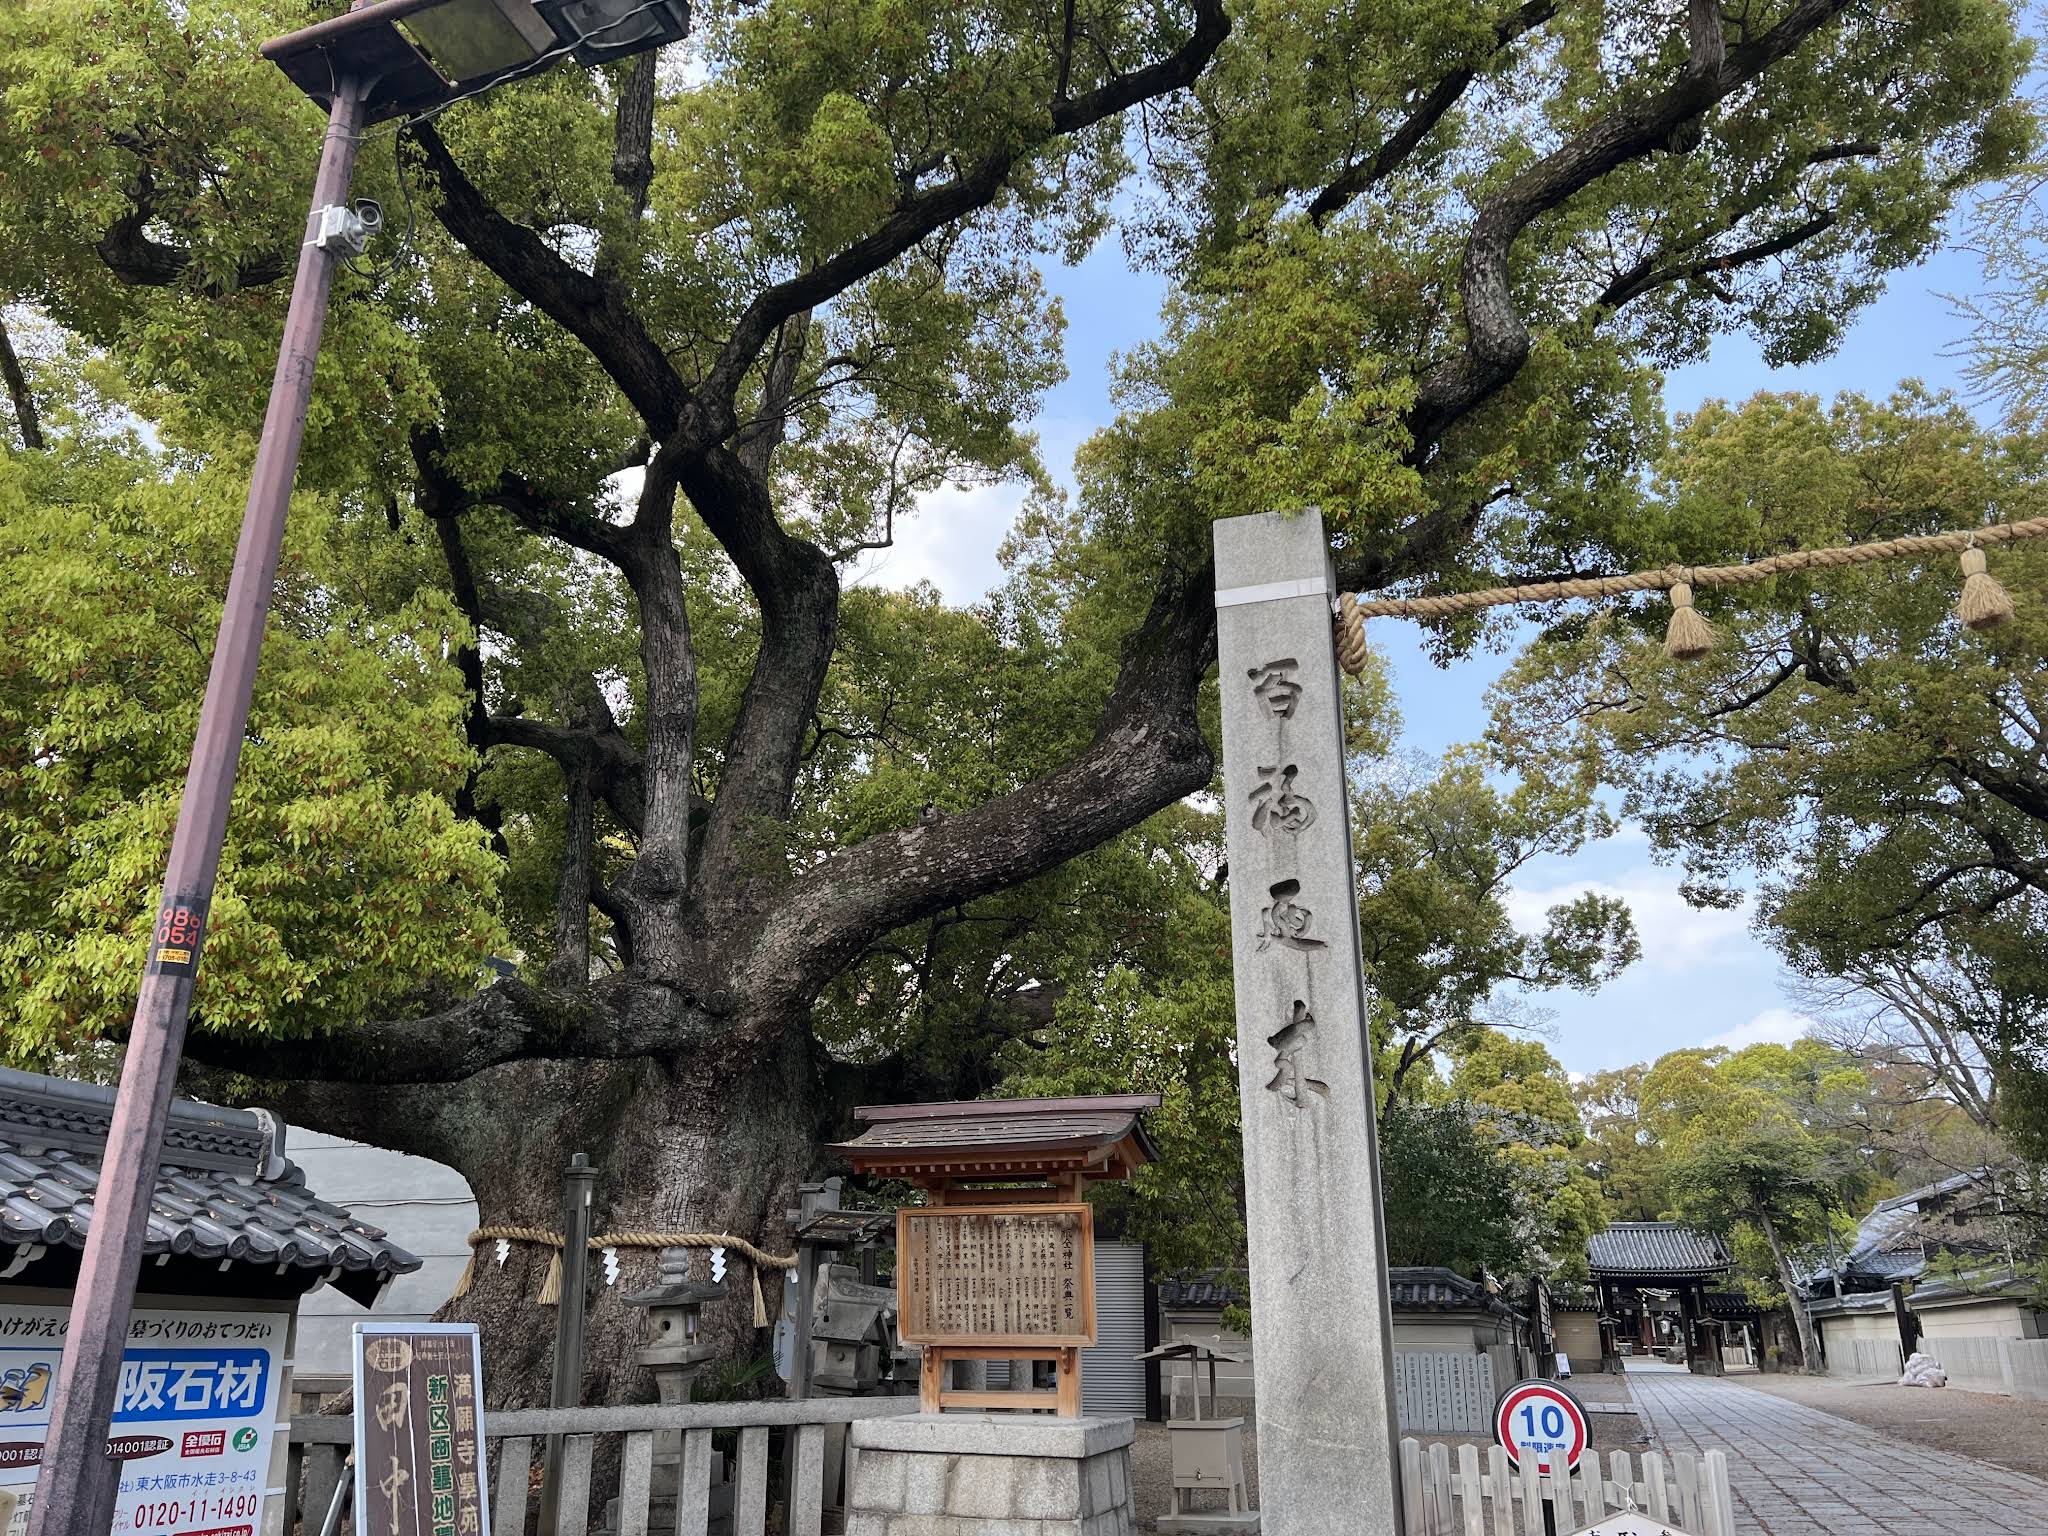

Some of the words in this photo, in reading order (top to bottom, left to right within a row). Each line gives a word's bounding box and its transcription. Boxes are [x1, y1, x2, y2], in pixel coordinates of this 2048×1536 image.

[126, 1319, 273, 1340] 墓づくりのおてつだい
[1520, 1405, 1564, 1439] 10
[135, 1494, 257, 1529] 0120-11-1490
